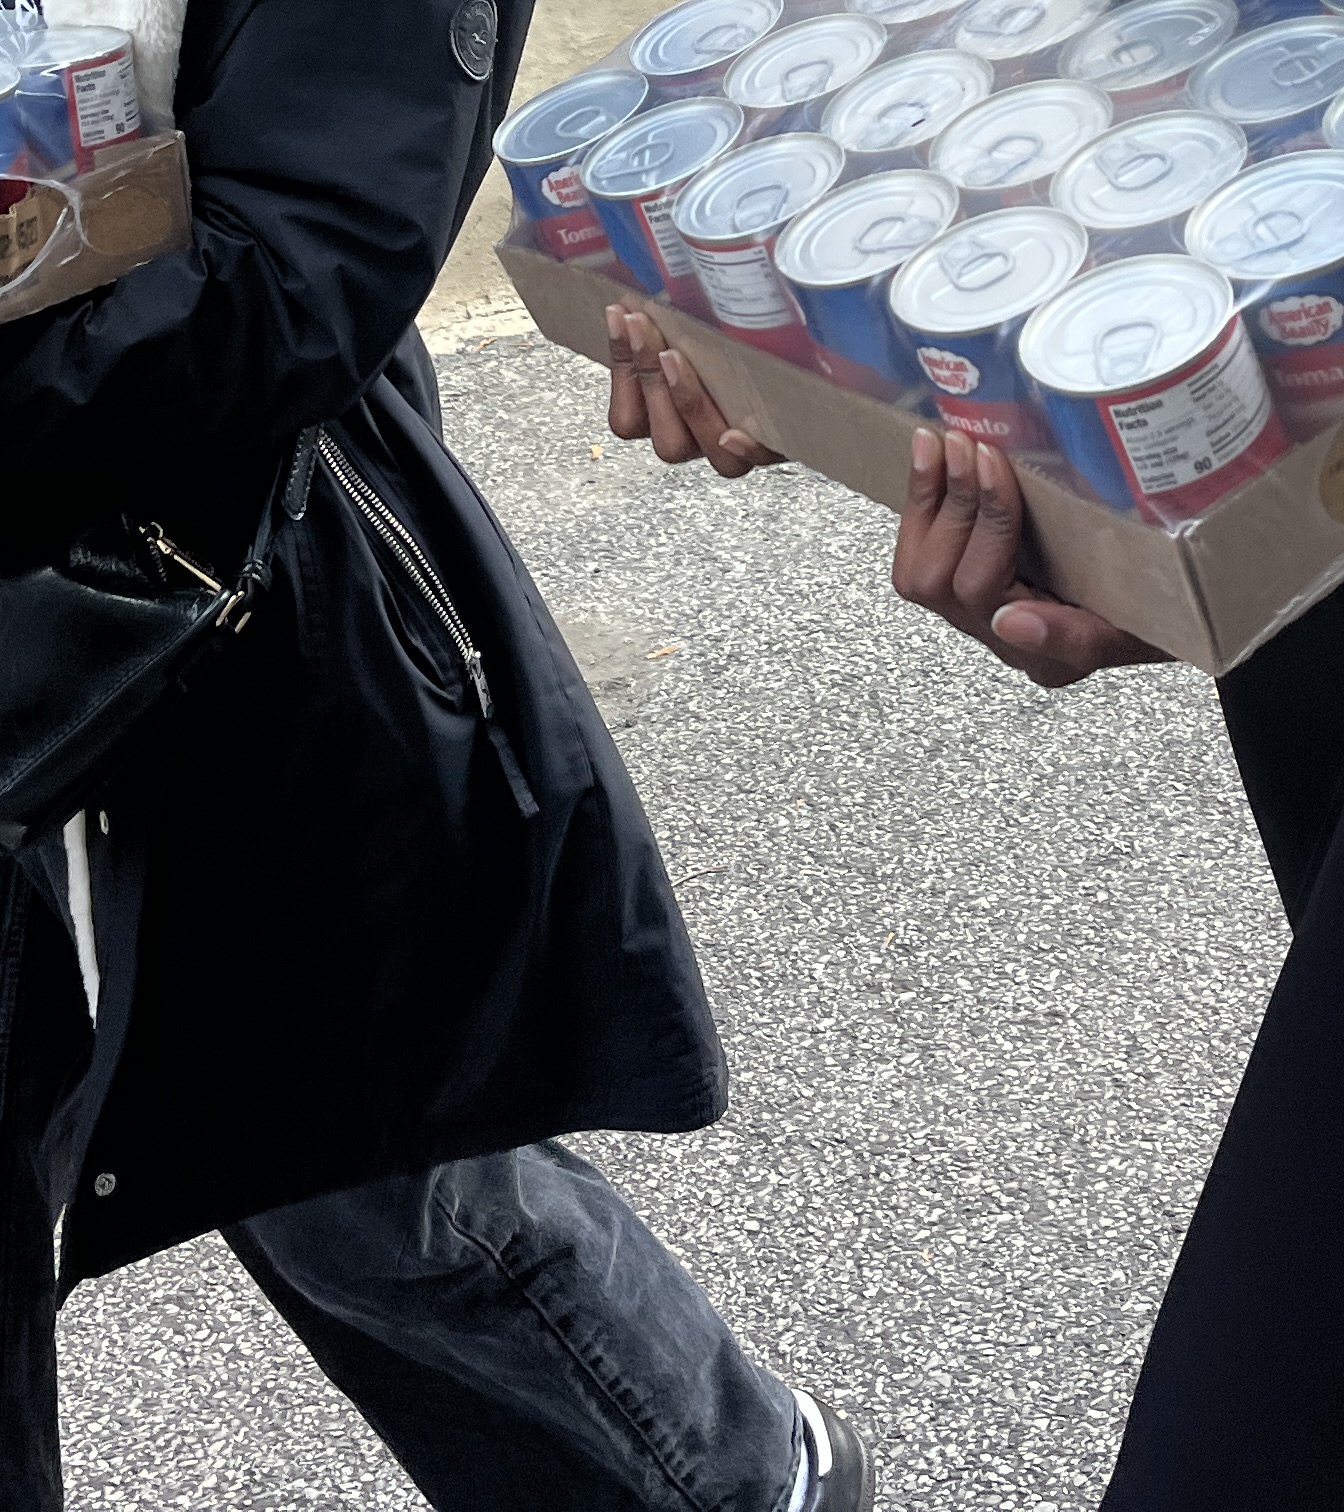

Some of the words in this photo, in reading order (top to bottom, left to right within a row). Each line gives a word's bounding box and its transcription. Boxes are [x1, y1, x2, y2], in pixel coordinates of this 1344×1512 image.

[1113, 399, 1163, 418] Nutrition
[1119, 418, 1149, 431] Facts
[1194, 456, 1213, 475] 90
